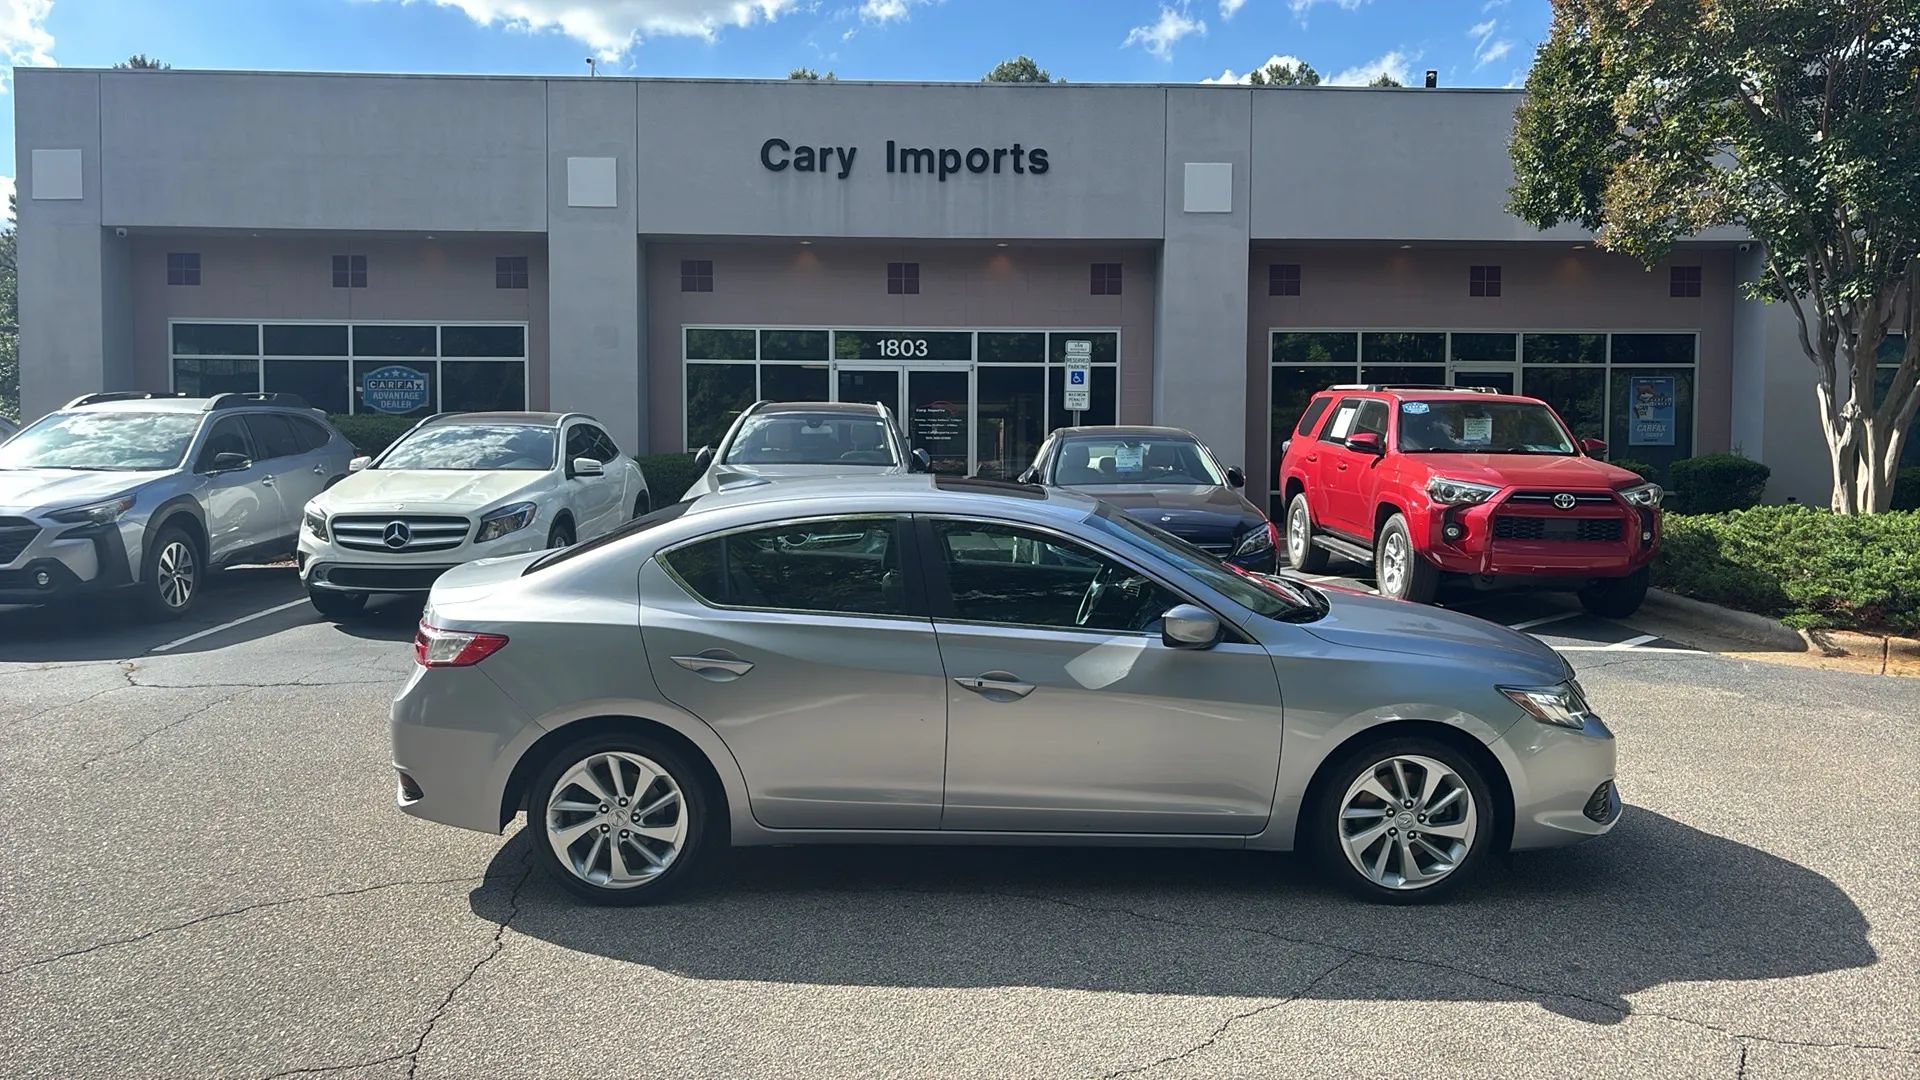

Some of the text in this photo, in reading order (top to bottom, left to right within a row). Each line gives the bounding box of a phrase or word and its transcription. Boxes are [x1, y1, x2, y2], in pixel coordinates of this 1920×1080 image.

[760, 138, 1050, 182] Cary Imports
[876, 339, 929, 357] 1803
[368, 380, 424, 390] CARFAX
[372, 391, 420, 400] ADVANTAGE
[380, 400, 412, 409] DEALER
